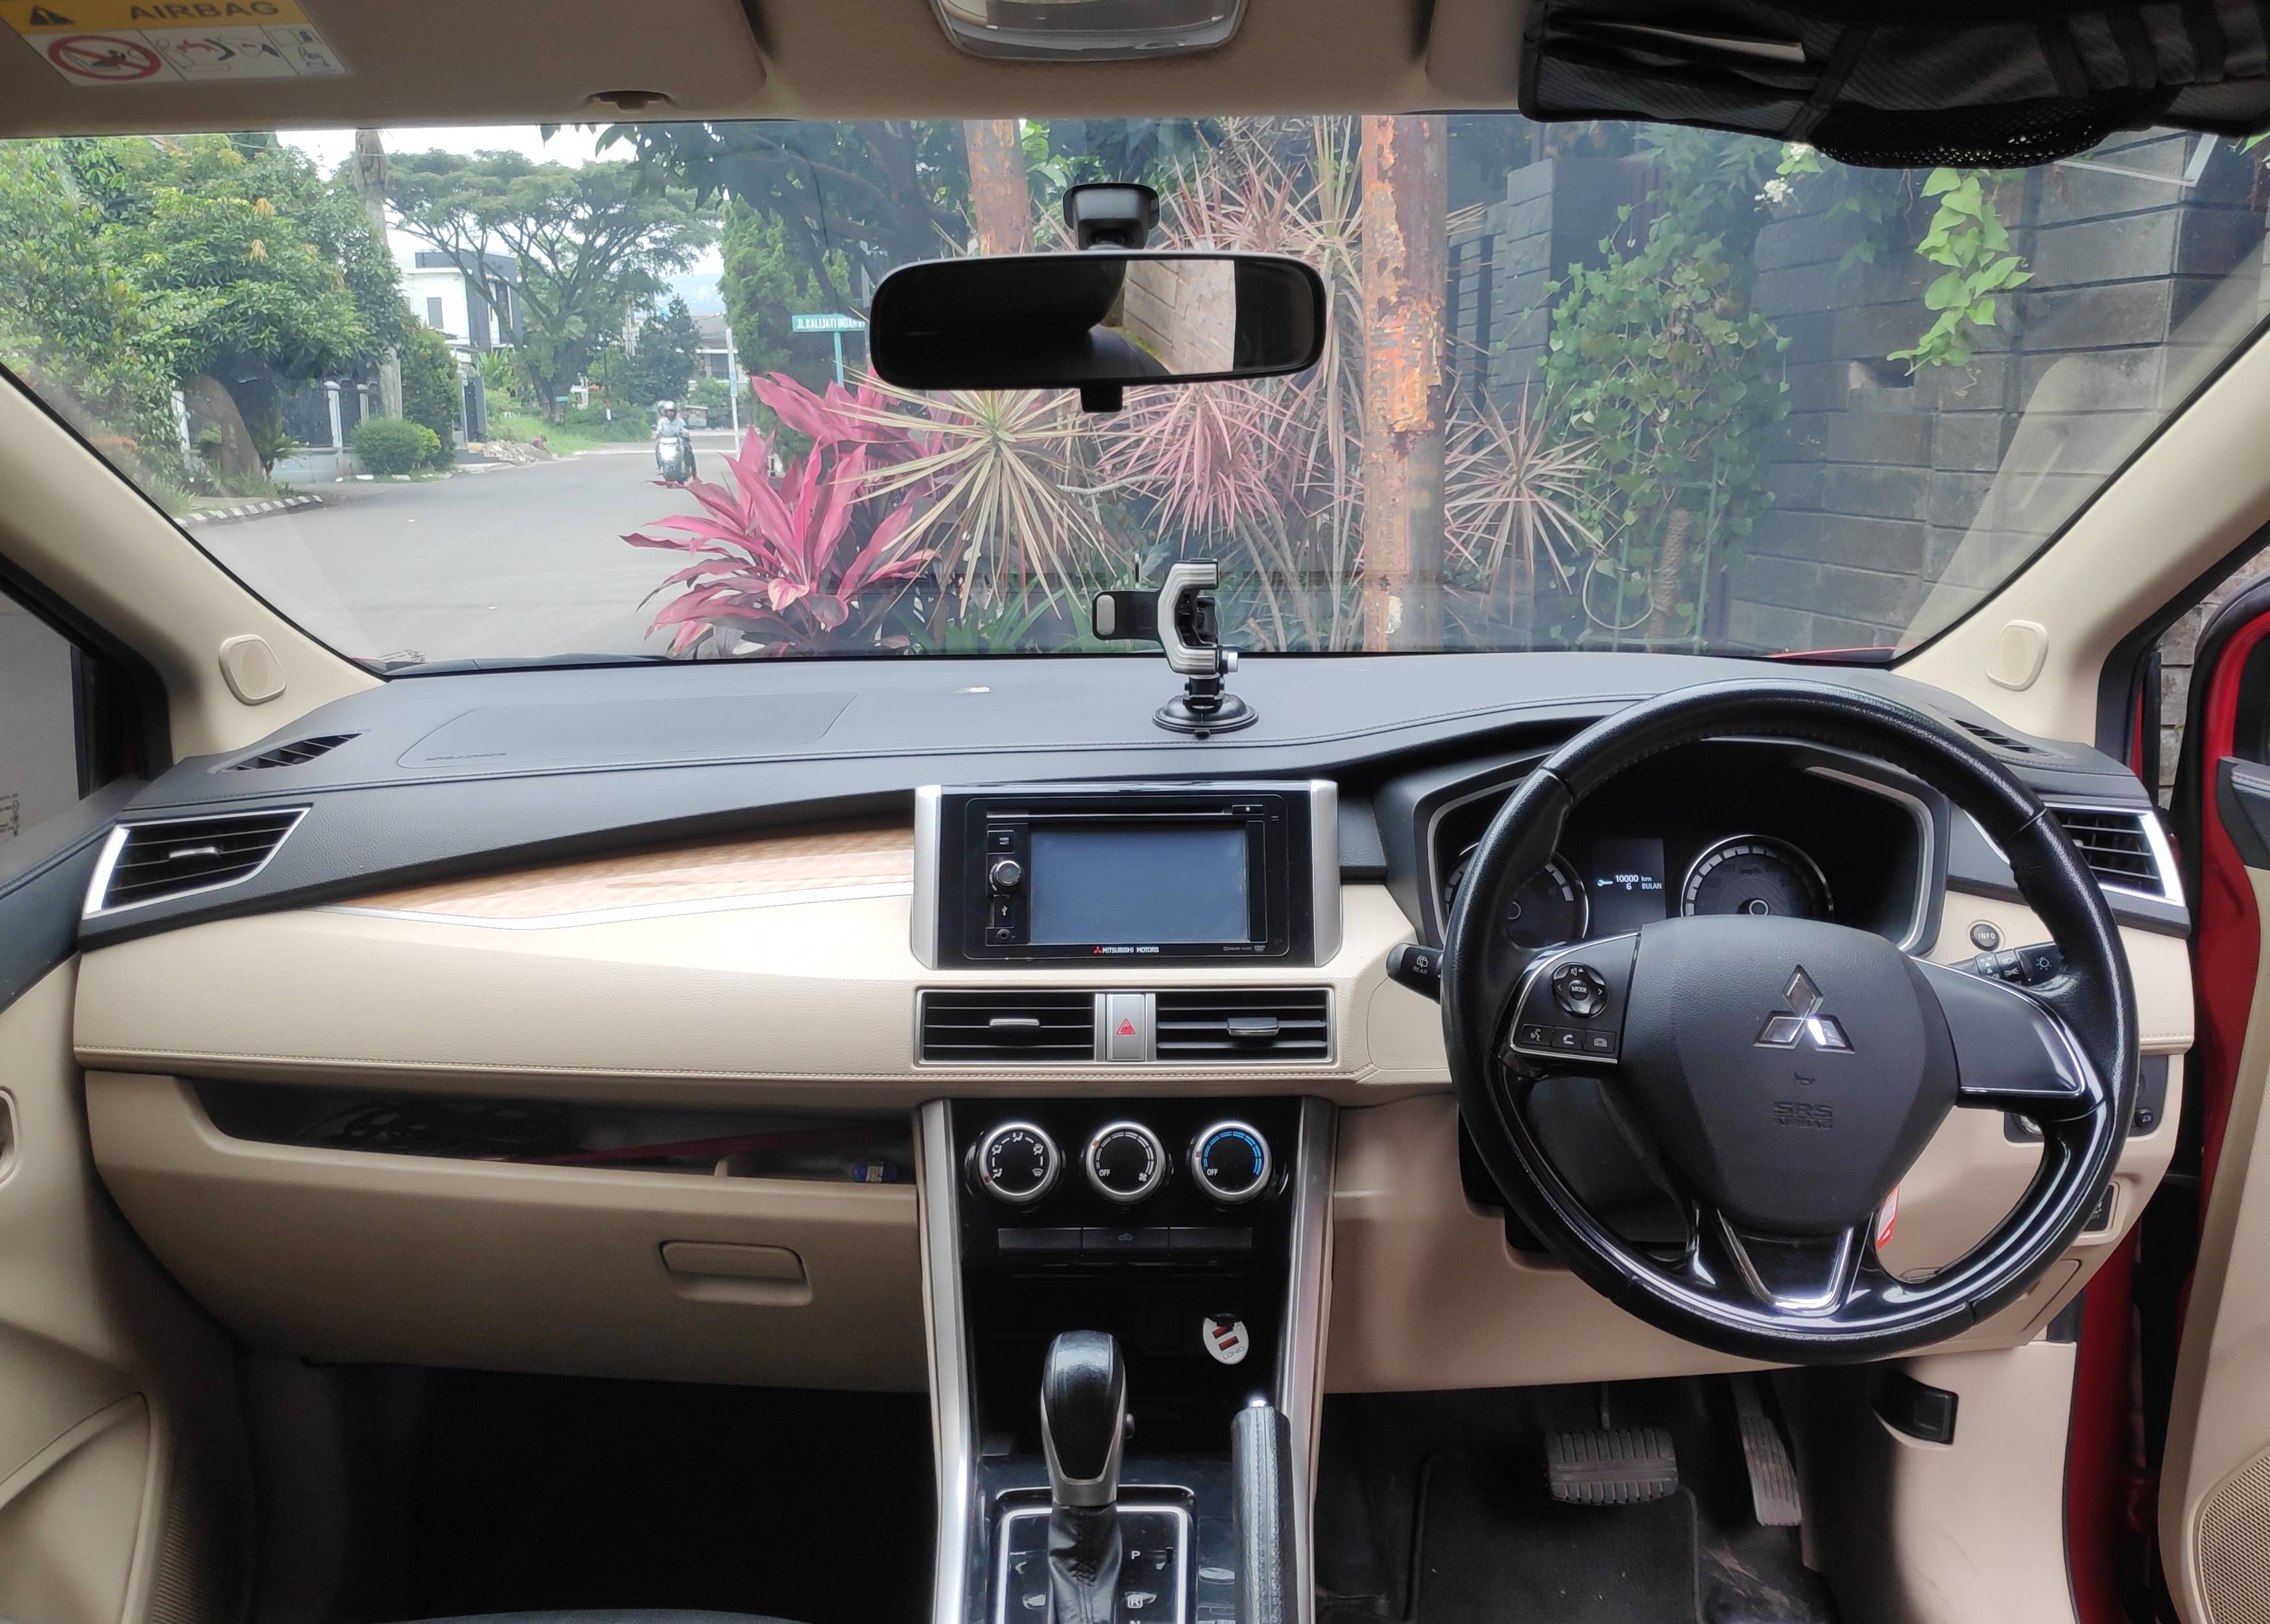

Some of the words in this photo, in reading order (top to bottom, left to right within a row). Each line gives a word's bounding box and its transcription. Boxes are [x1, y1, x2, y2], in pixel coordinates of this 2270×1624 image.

[131, 2, 278, 20] AIRBAG
[1615, 874, 1639, 883] 10000
[1413, 966, 1428, 975] REAR
[1774, 1102, 1833, 1116] SRS
[1774, 1116, 1833, 1128] AIRBAG
[1131, 1550, 1141, 1560] P
[1130, 1597, 1140, 1606] R
